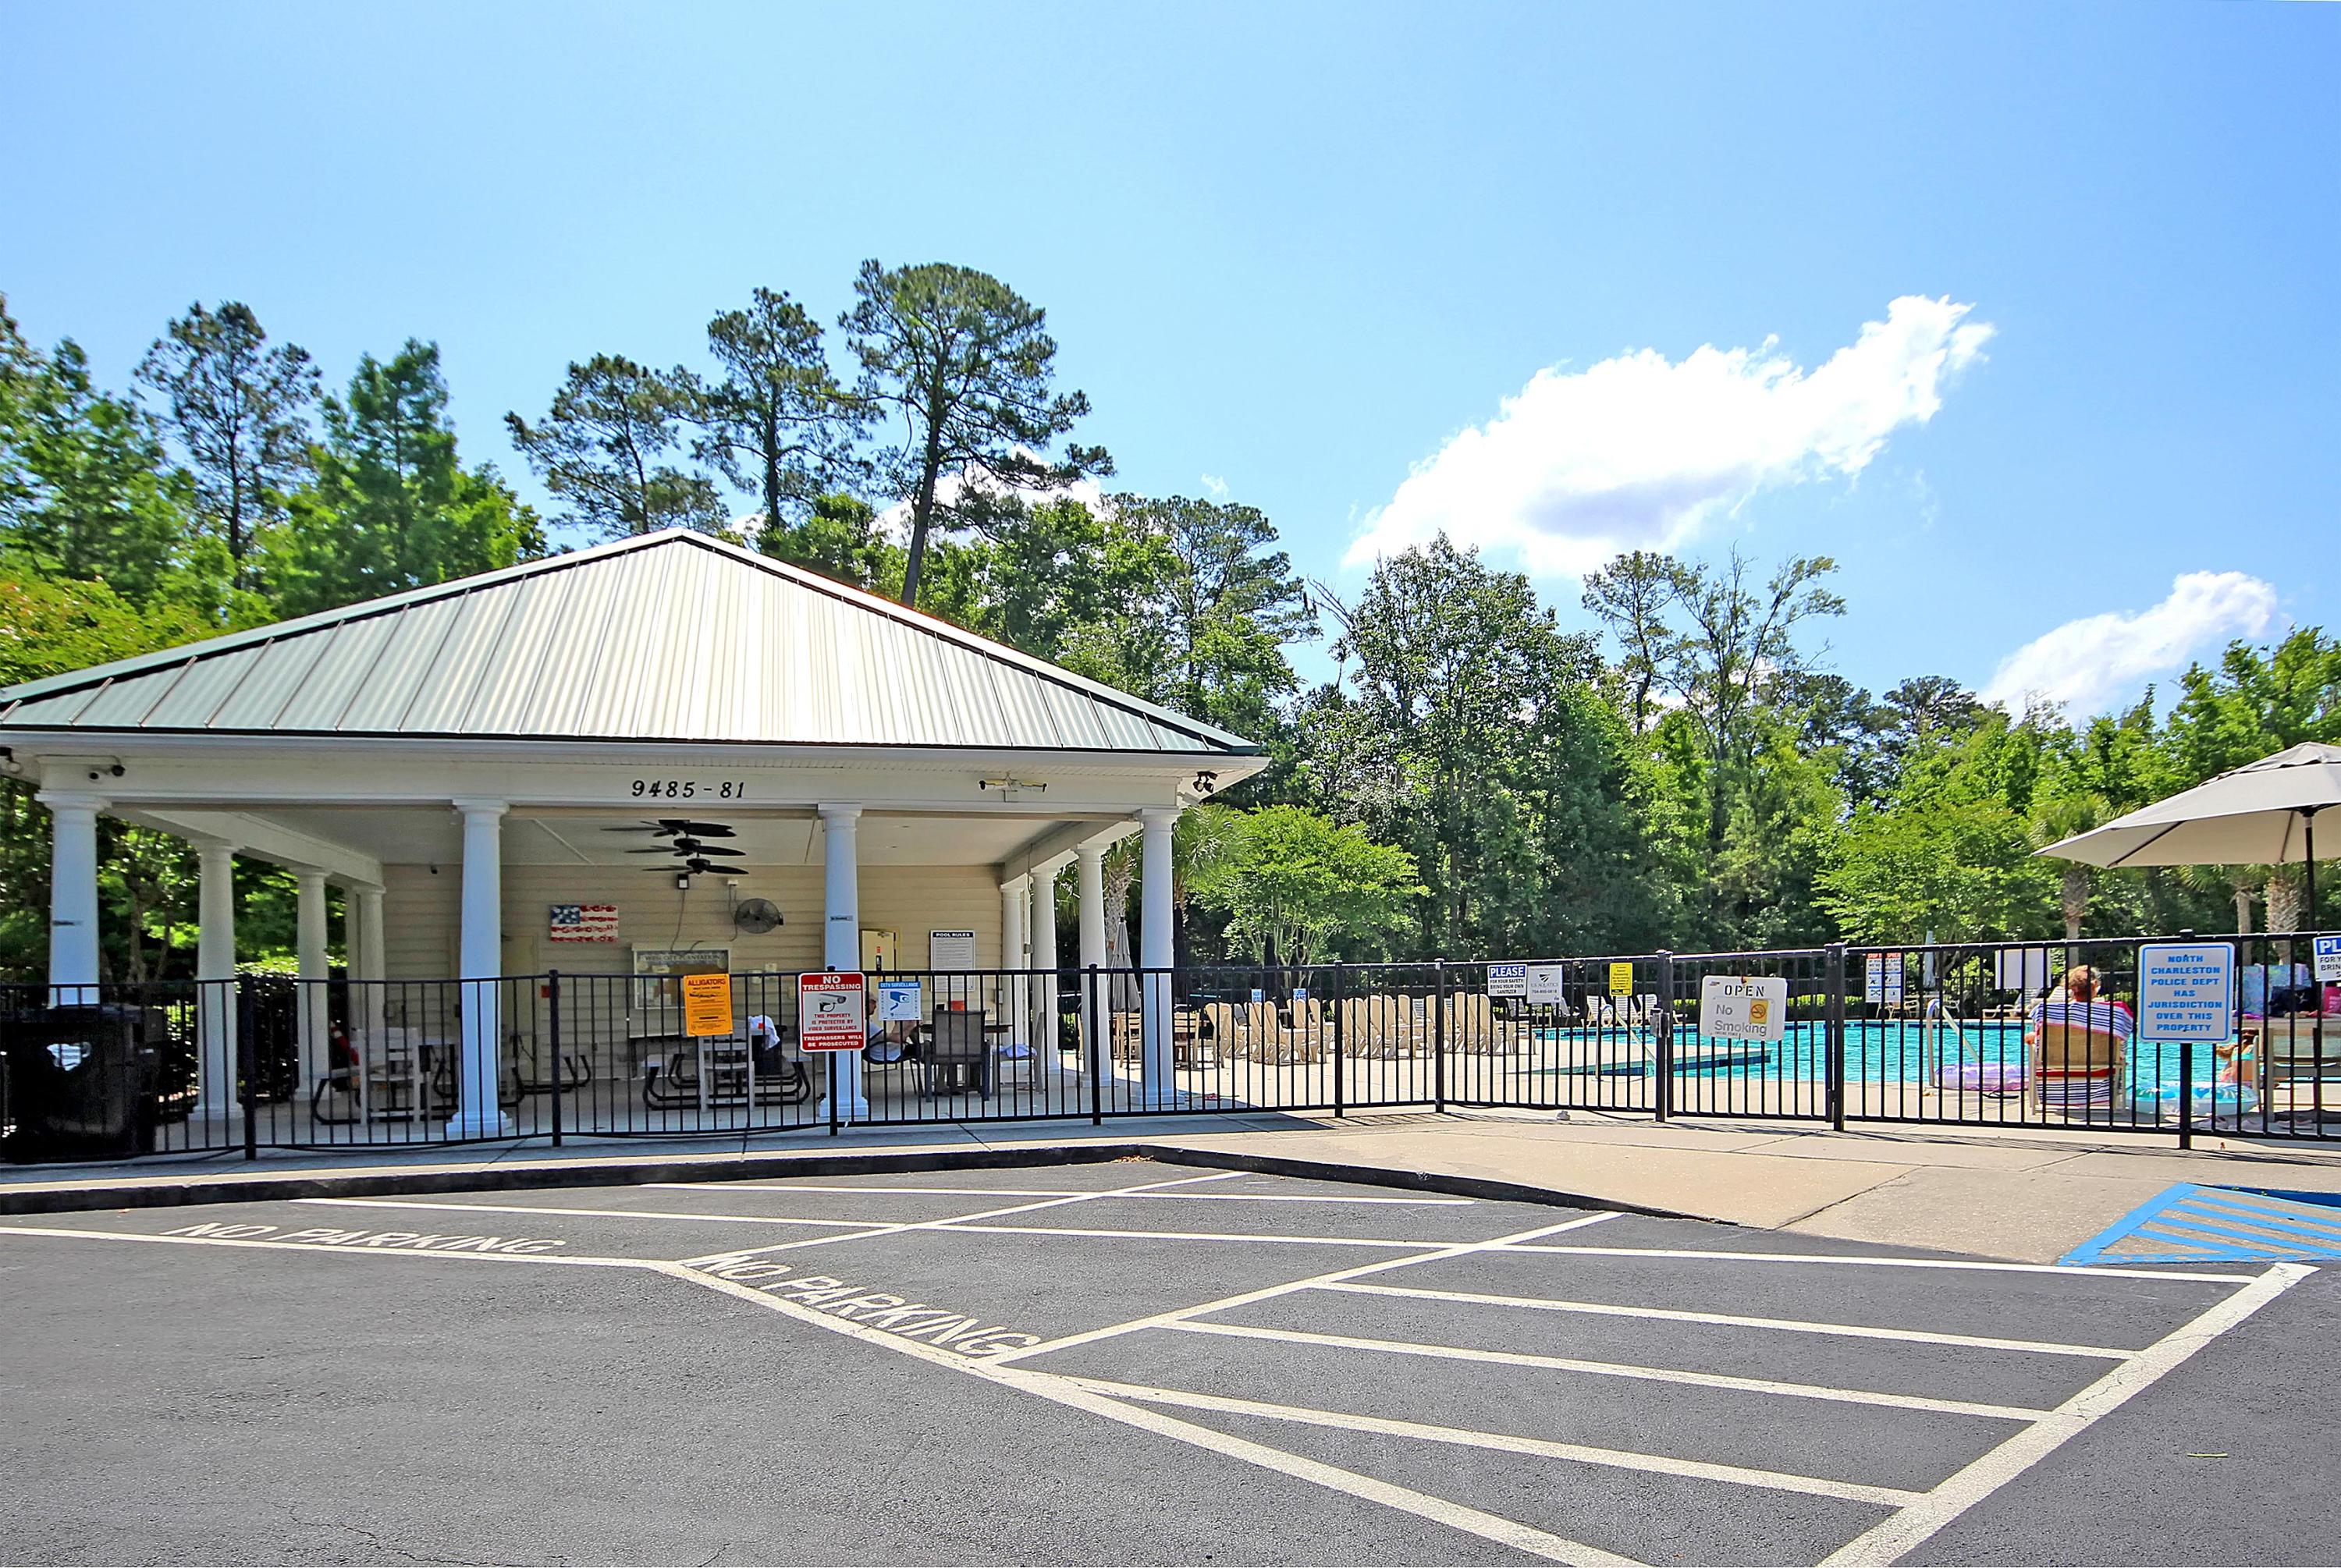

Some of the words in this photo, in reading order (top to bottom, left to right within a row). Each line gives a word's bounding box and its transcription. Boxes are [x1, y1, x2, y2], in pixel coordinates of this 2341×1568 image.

[2319, 939, 2341, 953] PL
[1490, 967, 1524, 977] PLEASE
[822, 975, 841, 984] NO
[1725, 984, 1764, 997] OPEN
[1716, 1004, 1733, 1016] No
[1714, 1020, 1767, 1036] Smoking
[158, 1222, 279, 1239] NO
[265, 1228, 567, 1254] PARKING
[684, 1254, 793, 1280] NO
[760, 1275, 1041, 1356] PARKING
